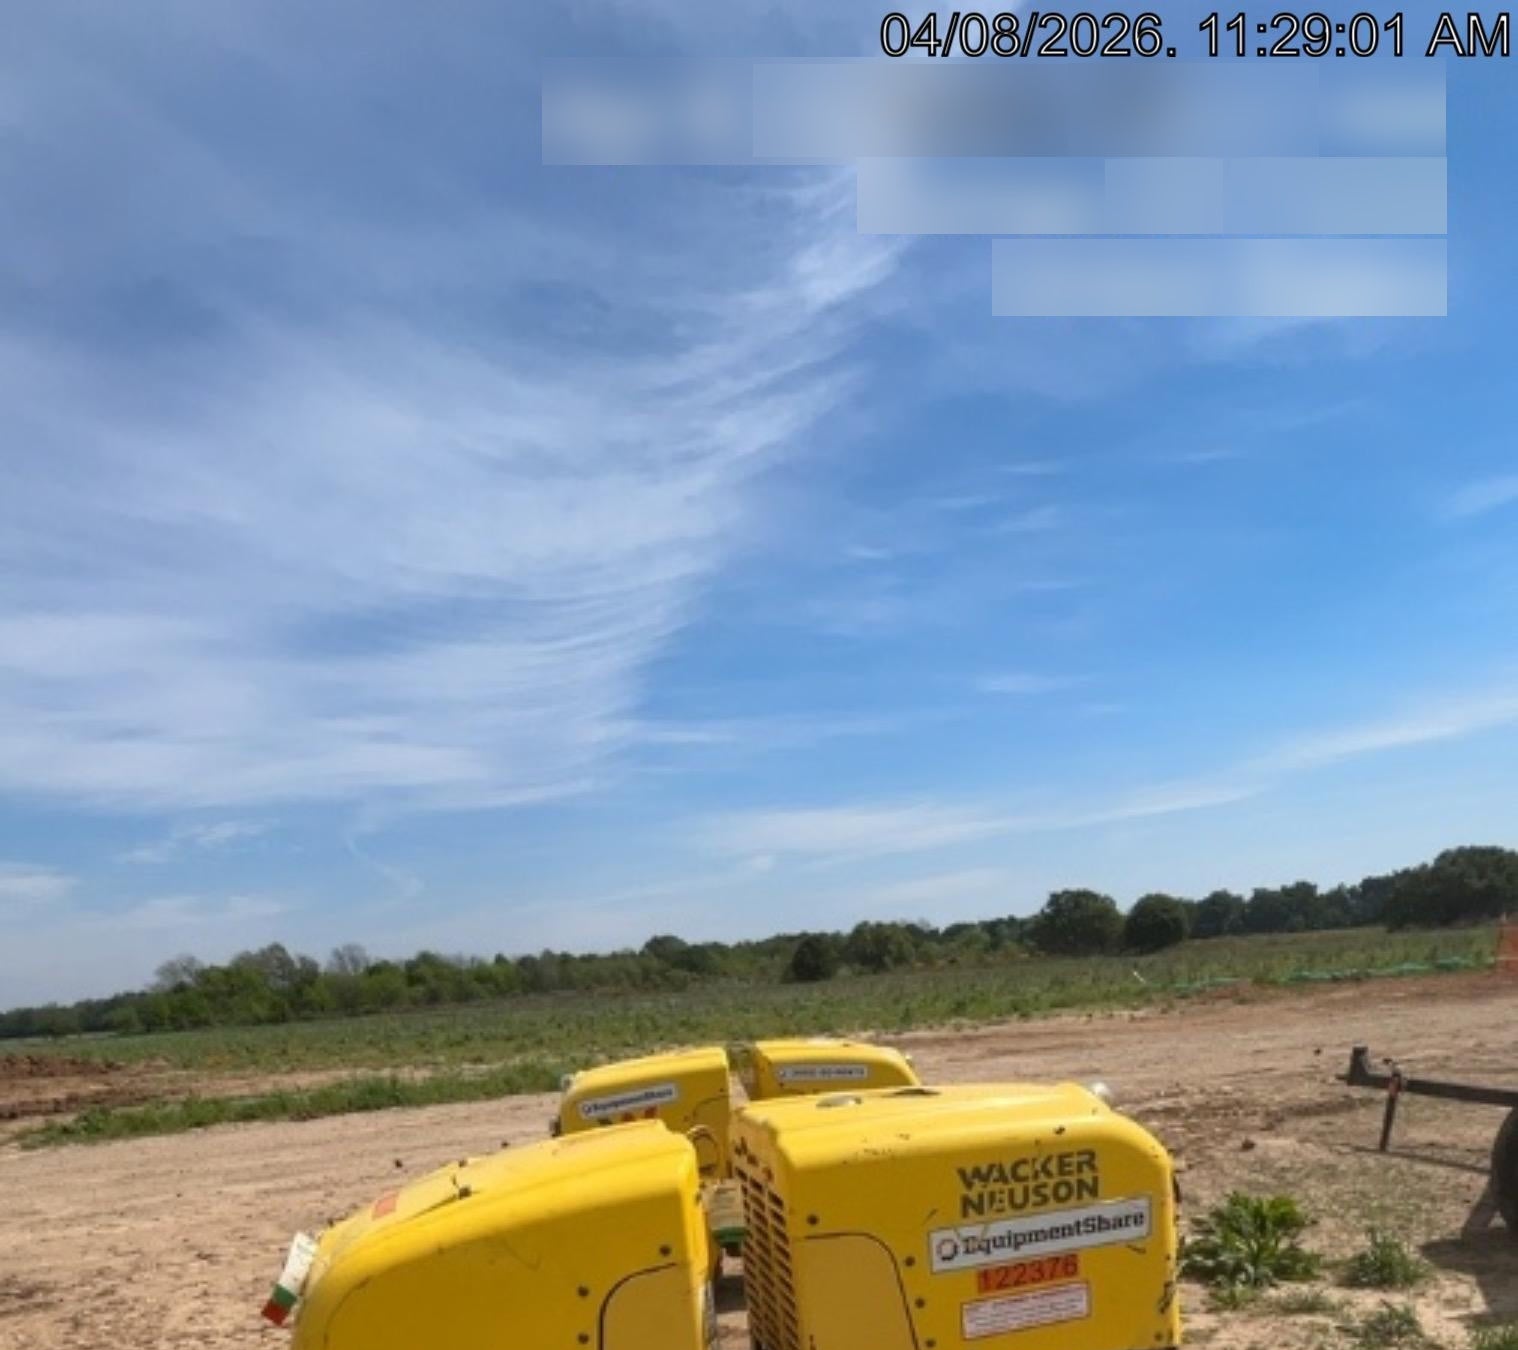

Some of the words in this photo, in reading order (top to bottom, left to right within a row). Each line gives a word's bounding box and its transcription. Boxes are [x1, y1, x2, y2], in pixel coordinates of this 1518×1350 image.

[957, 1150, 1097, 1191] WACKER
[961, 1176, 1100, 1219] NEUSON
[962, 1211, 1145, 1256] EquipmentShare
